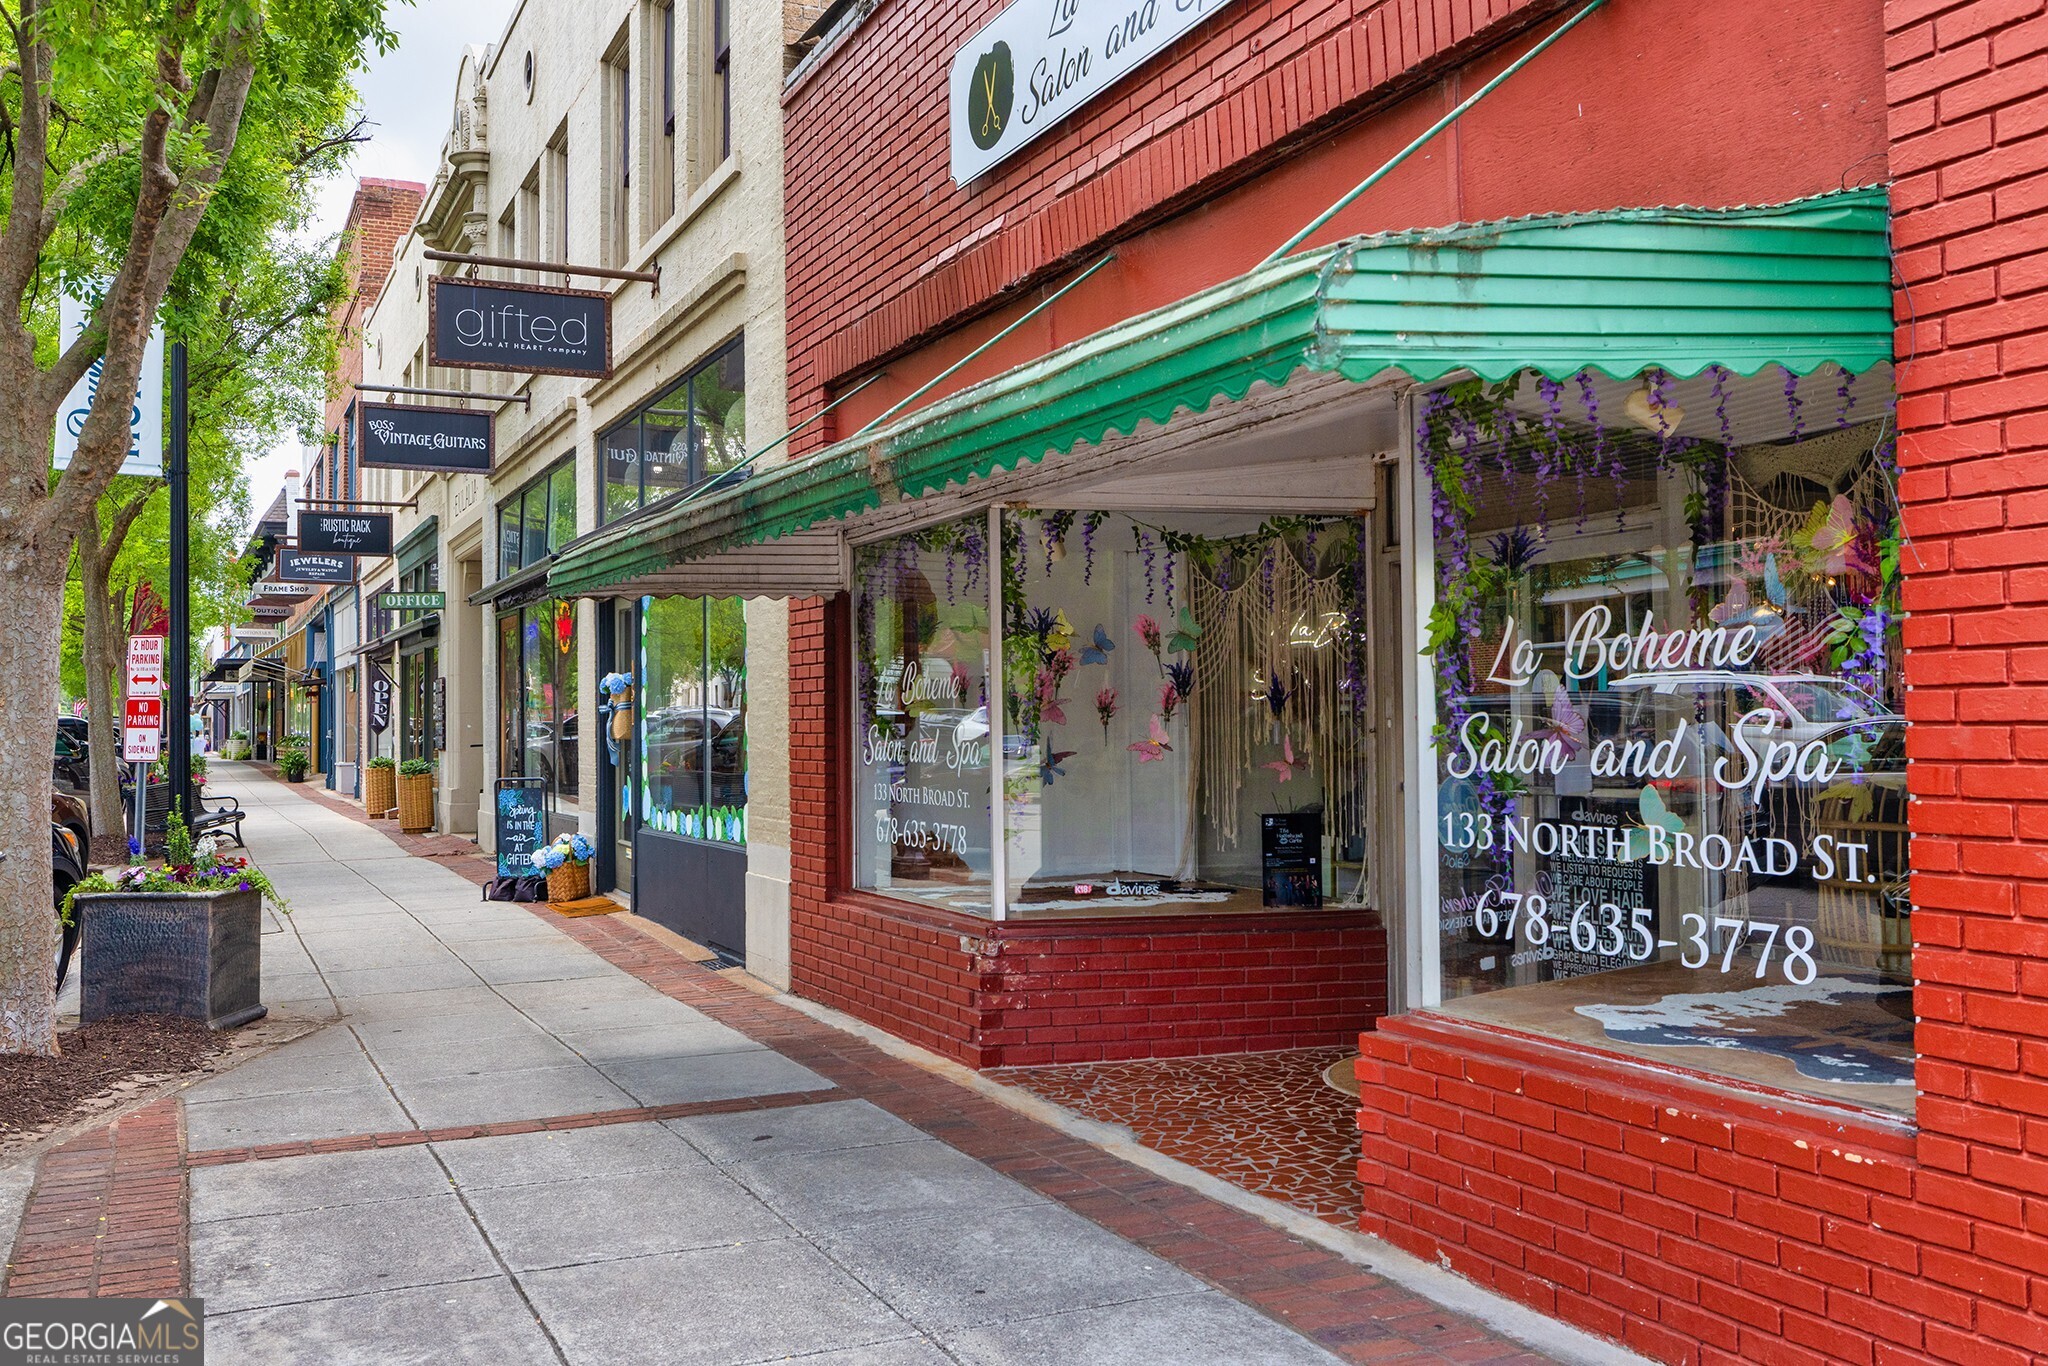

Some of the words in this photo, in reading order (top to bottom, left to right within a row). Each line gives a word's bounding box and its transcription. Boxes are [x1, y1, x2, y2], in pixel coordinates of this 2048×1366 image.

[1022, 46, 1095, 125] Salon
[1105, 0, 1160, 60] and
[455, 304, 588, 347] gifted
[513, 343, 543, 351] HEART
[547, 347, 588, 356] company
[368, 419, 395, 431] BOSS
[374, 429, 432, 446] VINTAGE
[429, 433, 487, 450] GUITARS
[323, 518, 349, 532] RUSTIC
[351, 519, 371, 533] RACK
[290, 557, 344, 569] JEWELERS
[385, 594, 440, 607] OFFICE
[253, 607, 287, 615] BOUTIQUE
[134, 640, 138, 650] 2
[140, 640, 159, 650] HOUR
[1486, 614, 1543, 687] La
[1563, 604, 1763, 681] Boheme
[131, 653, 160, 665] PARKING
[901, 660, 961, 706] Boheme
[138, 702, 148, 713] NO
[370, 680, 389, 727] OPEN
[127, 714, 159, 726] PARKING
[138, 734, 147, 742] ON
[127, 745, 156, 754] SIDEWALK
[863, 724, 906, 766] Salon
[909, 728, 940, 765] and
[946, 722, 984, 778] Spa
[1446, 711, 1571, 781] Salon
[1590, 717, 1688, 780] and
[1713, 707, 1844, 805] Spa
[873, 783, 888, 801] 133
[508, 804, 537, 821] Spring
[1571, 801, 1618, 825] davines
[506, 820, 513, 829] IS
[515, 821, 522, 830] IN
[522, 821, 535, 830] THE
[508, 833, 534, 842] air
[875, 815, 968, 855] 678-635-3778
[514, 843, 525, 853] AT
[1443, 811, 1494, 851] 133
[1504, 818, 1633, 862] NORTH
[1646, 825, 1799, 878] BROAD
[506, 853, 532, 865] GIFTED
[1550, 862, 1561, 872] WE
[1562, 863, 1588, 875] LISTEN
[1589, 865, 1600, 875] TO
[1601, 867, 1643, 880] REQUESTS
[1106, 877, 1159, 895] davines
[1551, 873, 1562, 884] WE
[1563, 874, 1583, 886] CARE
[1584, 877, 1610, 888] ABOUT
[1612, 879, 1643, 892] PEOPLE
[1574, 887, 1608, 905] LOVE
[1612, 891, 1644, 909] HAIR
[1475, 888, 1818, 985] 678-635-3778
[1553, 949, 1580, 962] GRACE
[1581, 953, 1598, 966] AND
[1563, 962, 1599, 973] APPRECIATE
